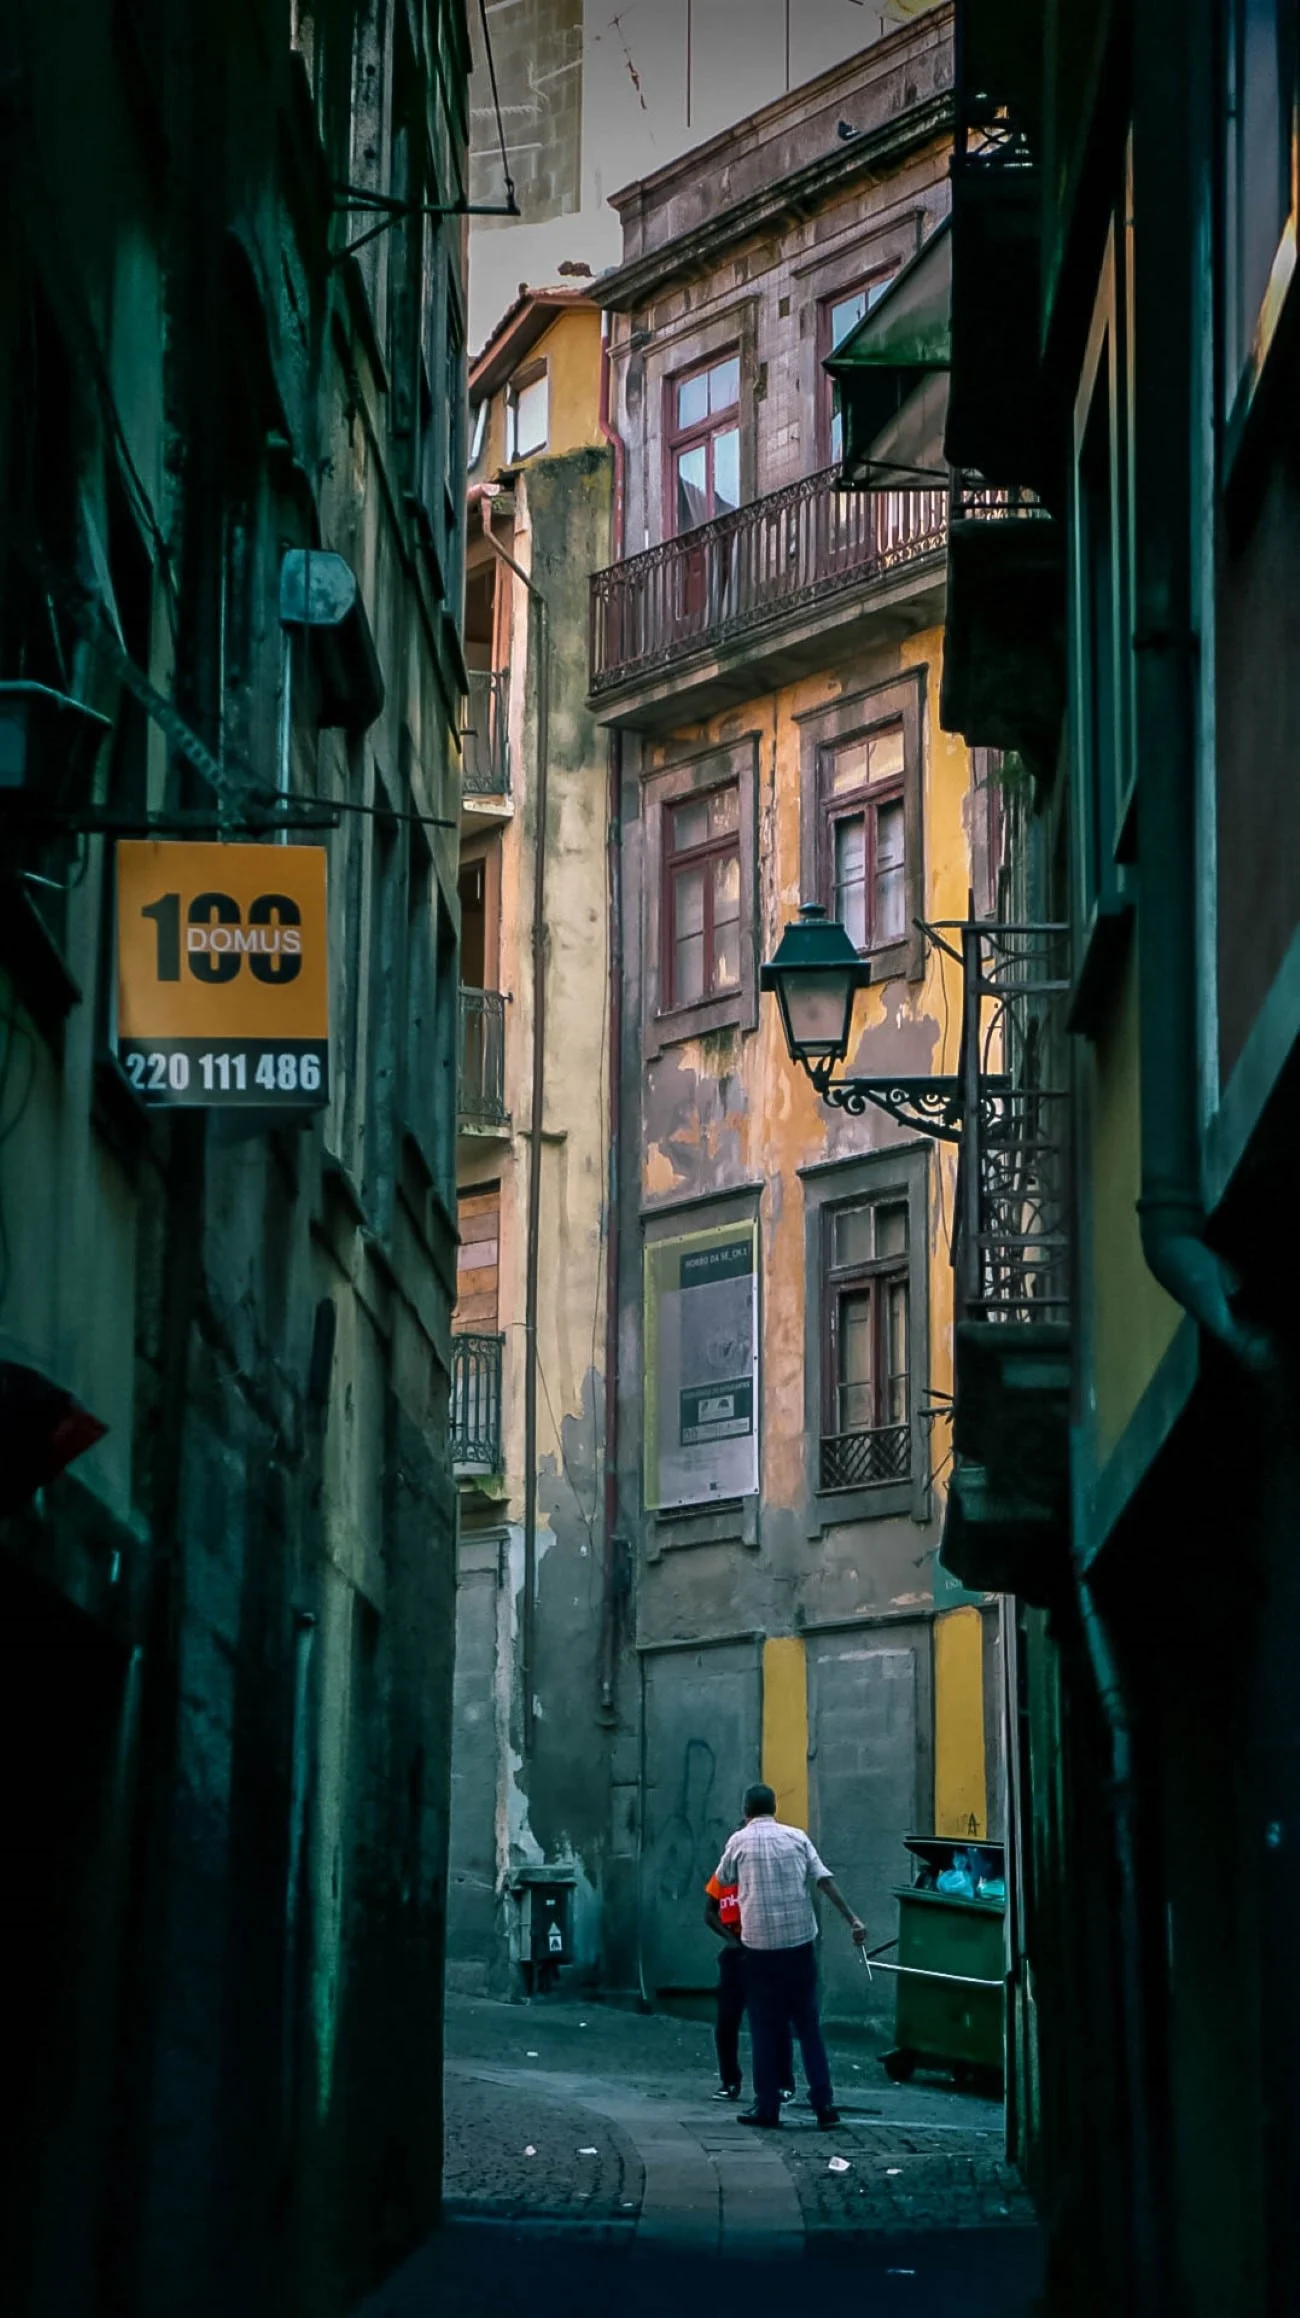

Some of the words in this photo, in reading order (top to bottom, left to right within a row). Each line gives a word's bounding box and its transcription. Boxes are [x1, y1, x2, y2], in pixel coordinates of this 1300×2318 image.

[141, 892, 302, 984] 100
[187, 927, 301, 954] DOMUS
[126, 1053, 189, 1090] 220
[199, 1053, 247, 1090] 111
[256, 1054, 321, 1090] 486
